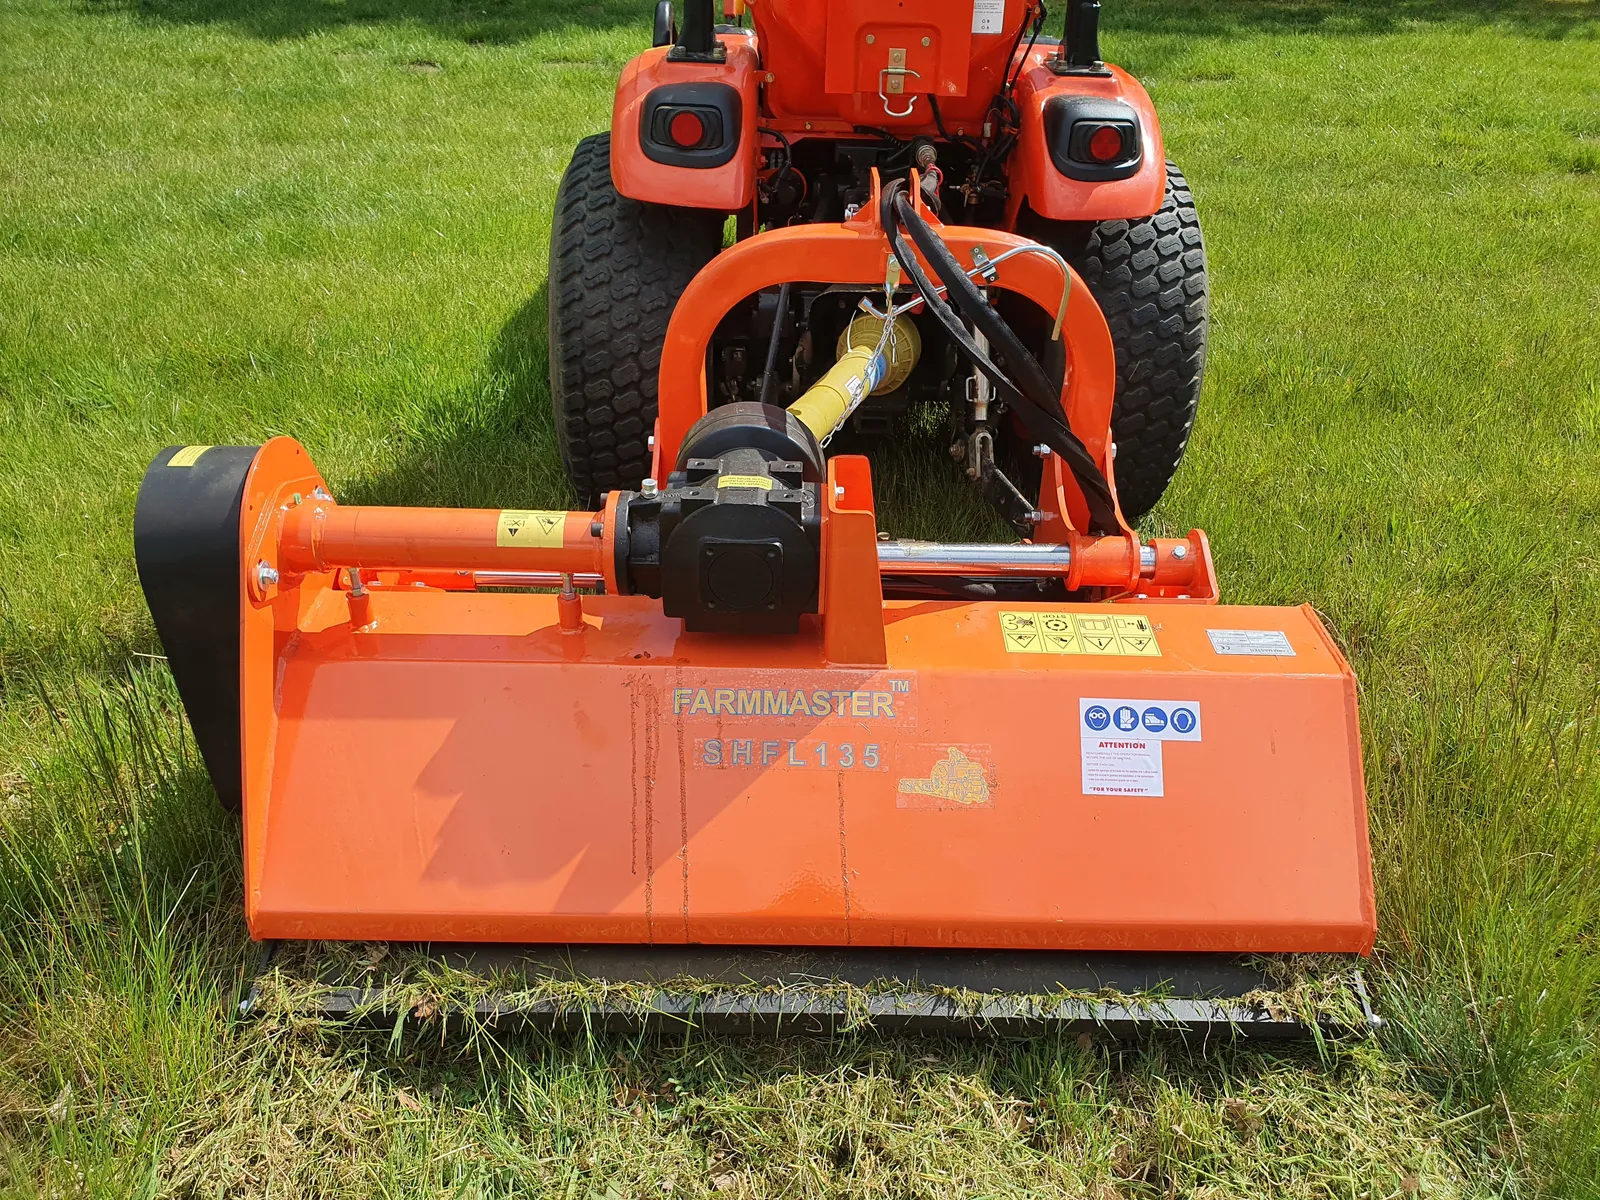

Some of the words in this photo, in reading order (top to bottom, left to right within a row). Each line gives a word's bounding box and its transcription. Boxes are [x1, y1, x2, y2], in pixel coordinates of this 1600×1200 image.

[673, 687, 896, 718] FARMMASTER
[888, 679, 910, 693] TM
[1098, 741, 1146, 750] ATTENTION
